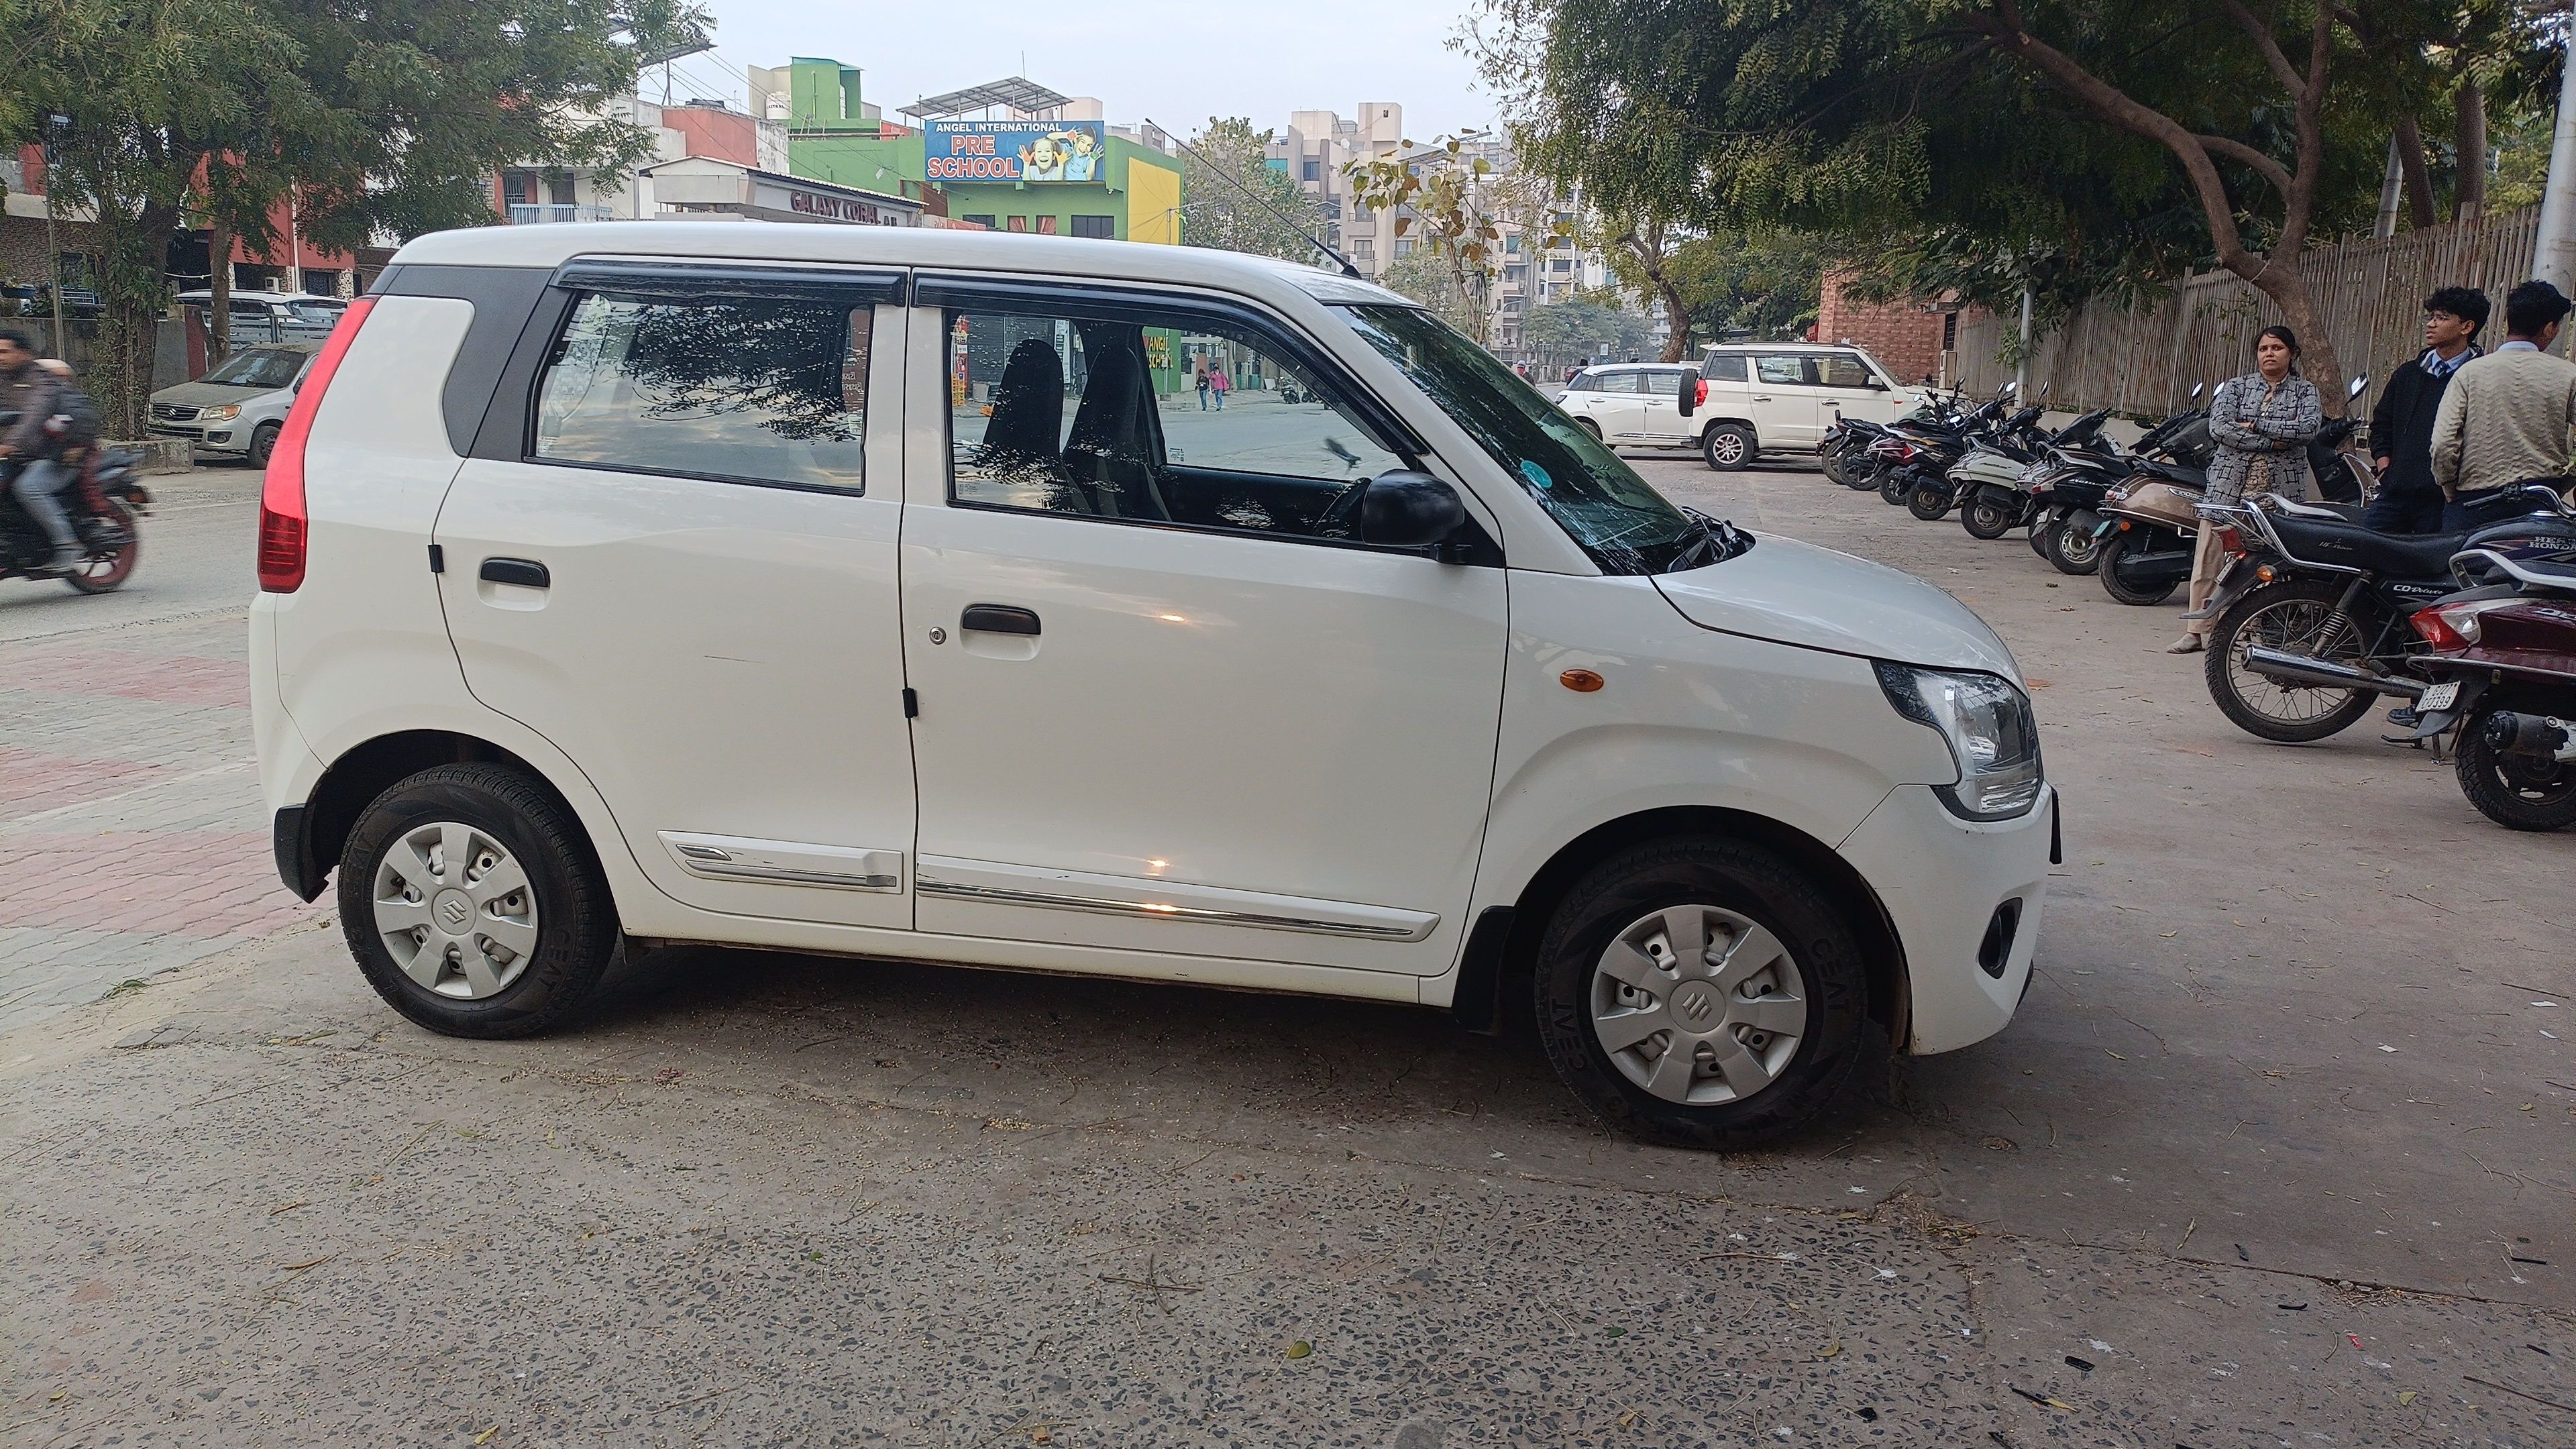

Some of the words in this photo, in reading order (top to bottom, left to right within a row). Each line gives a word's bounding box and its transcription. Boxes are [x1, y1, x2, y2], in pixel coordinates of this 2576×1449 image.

[936, 123, 972, 132] ANGEL
[975, 123, 1063, 132] INTERNATIONAL
[951, 135, 996, 156] PRE
[928, 157, 1020, 178] SCHOOL
[790, 191, 841, 217] GALAXY
[843, 200, 881, 225] CORAL
[1148, 354, 1173, 369] SCHL
[1811, 937, 1851, 1015] CEAT
[1551, 998, 1587, 1071] CEAT
